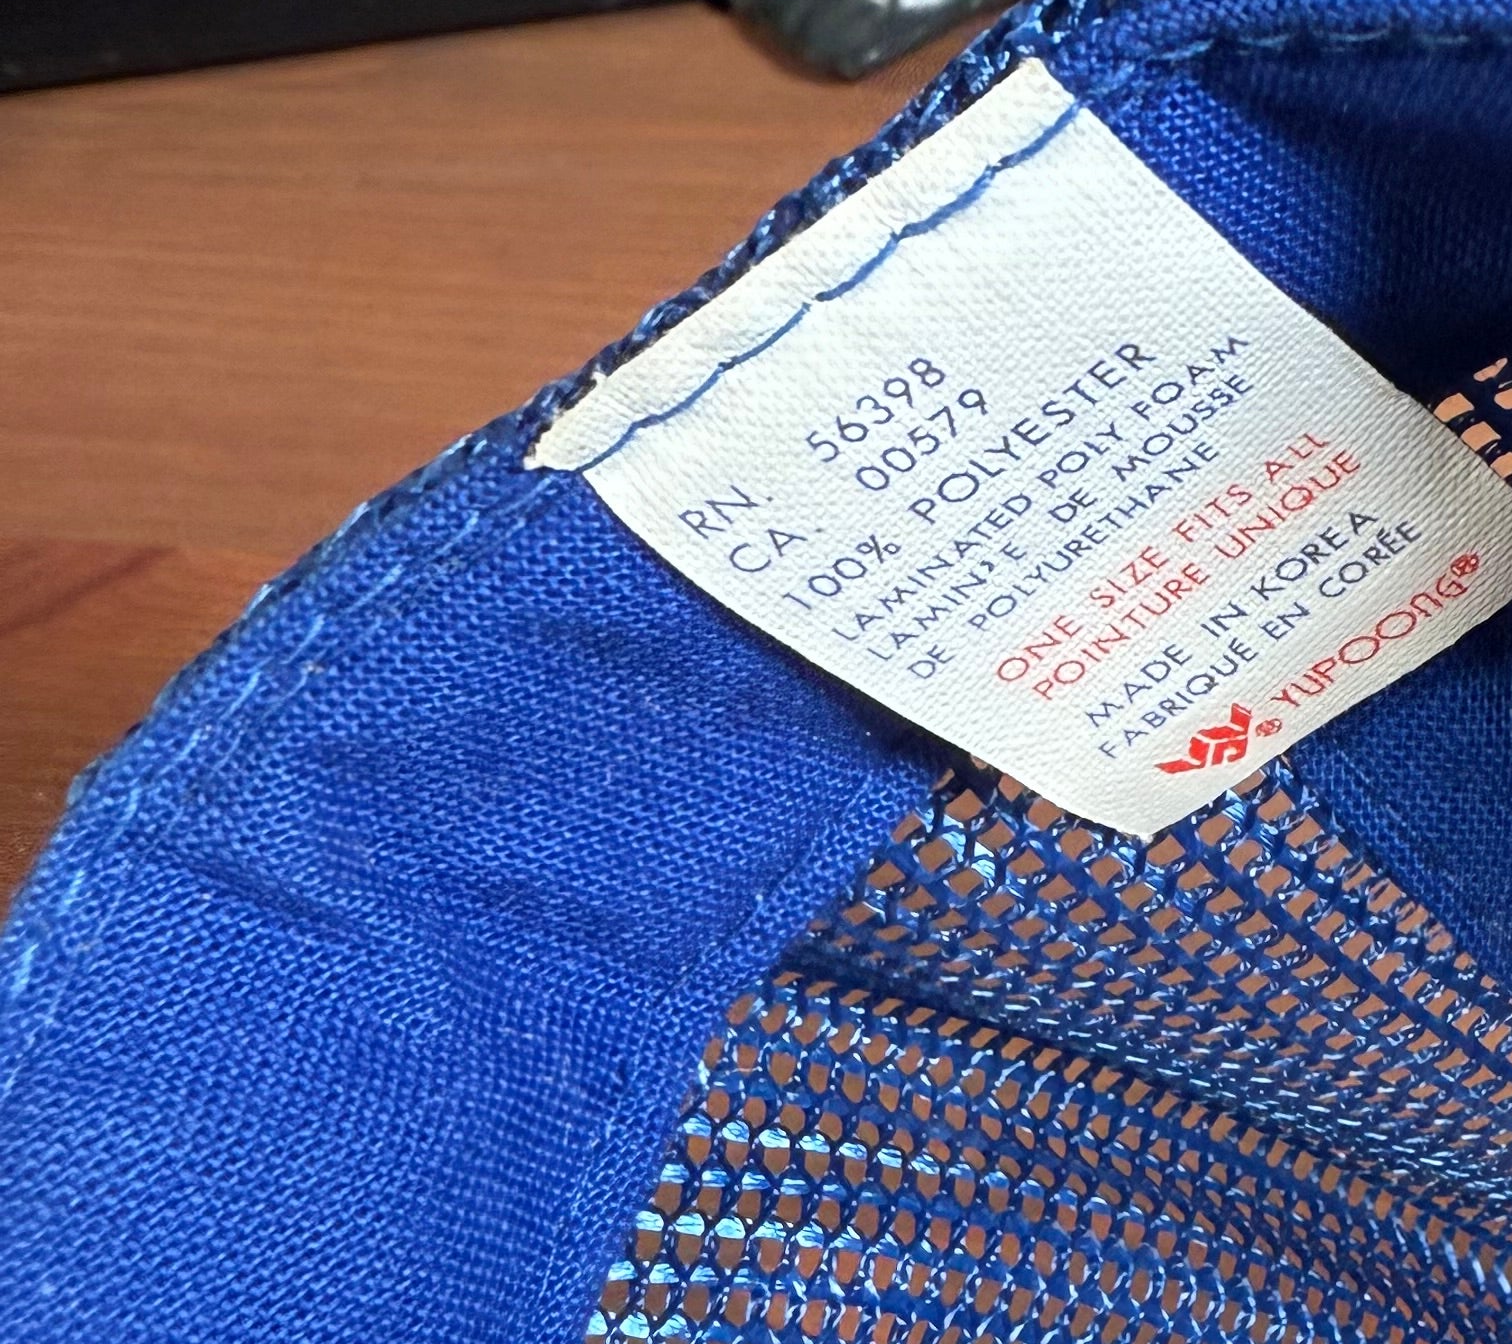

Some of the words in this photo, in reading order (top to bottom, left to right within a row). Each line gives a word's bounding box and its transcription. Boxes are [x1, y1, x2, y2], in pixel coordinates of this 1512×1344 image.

[678, 484, 774, 540] RN.
[805, 357, 946, 463] 56398
[728, 528, 824, 573] CA.
[855, 388, 988, 492] 00579
[782, 534, 902, 611] 100%
[907, 343, 1158, 525] POLYESTER
[831, 493, 1033, 642] LAMINATED
[1036, 421, 1124, 489] POLY
[1130, 336, 1250, 421] FOAM
[906, 644, 956, 680] DE
[967, 441, 1220, 632] POLYURETHANE
[996, 614, 1084, 682] ONE
[1088, 544, 1170, 609] SIZE
[1171, 483, 1252, 544] FITS
[1263, 432, 1330, 482] ALL
[1048, 487, 1098, 523] DE
[1111, 374, 1254, 483] MOUSSE
[1032, 561, 1211, 701] POINTURE
[1213, 450, 1362, 560] UNIQUE
[1085, 643, 1193, 728] MADE
[1200, 601, 1249, 638] IN
[1250, 511, 1379, 601] KOREA
[1098, 637, 1259, 759] FABRIQUE
[1258, 601, 1311, 642] EN
[1318, 520, 1423, 598] CORÉE
